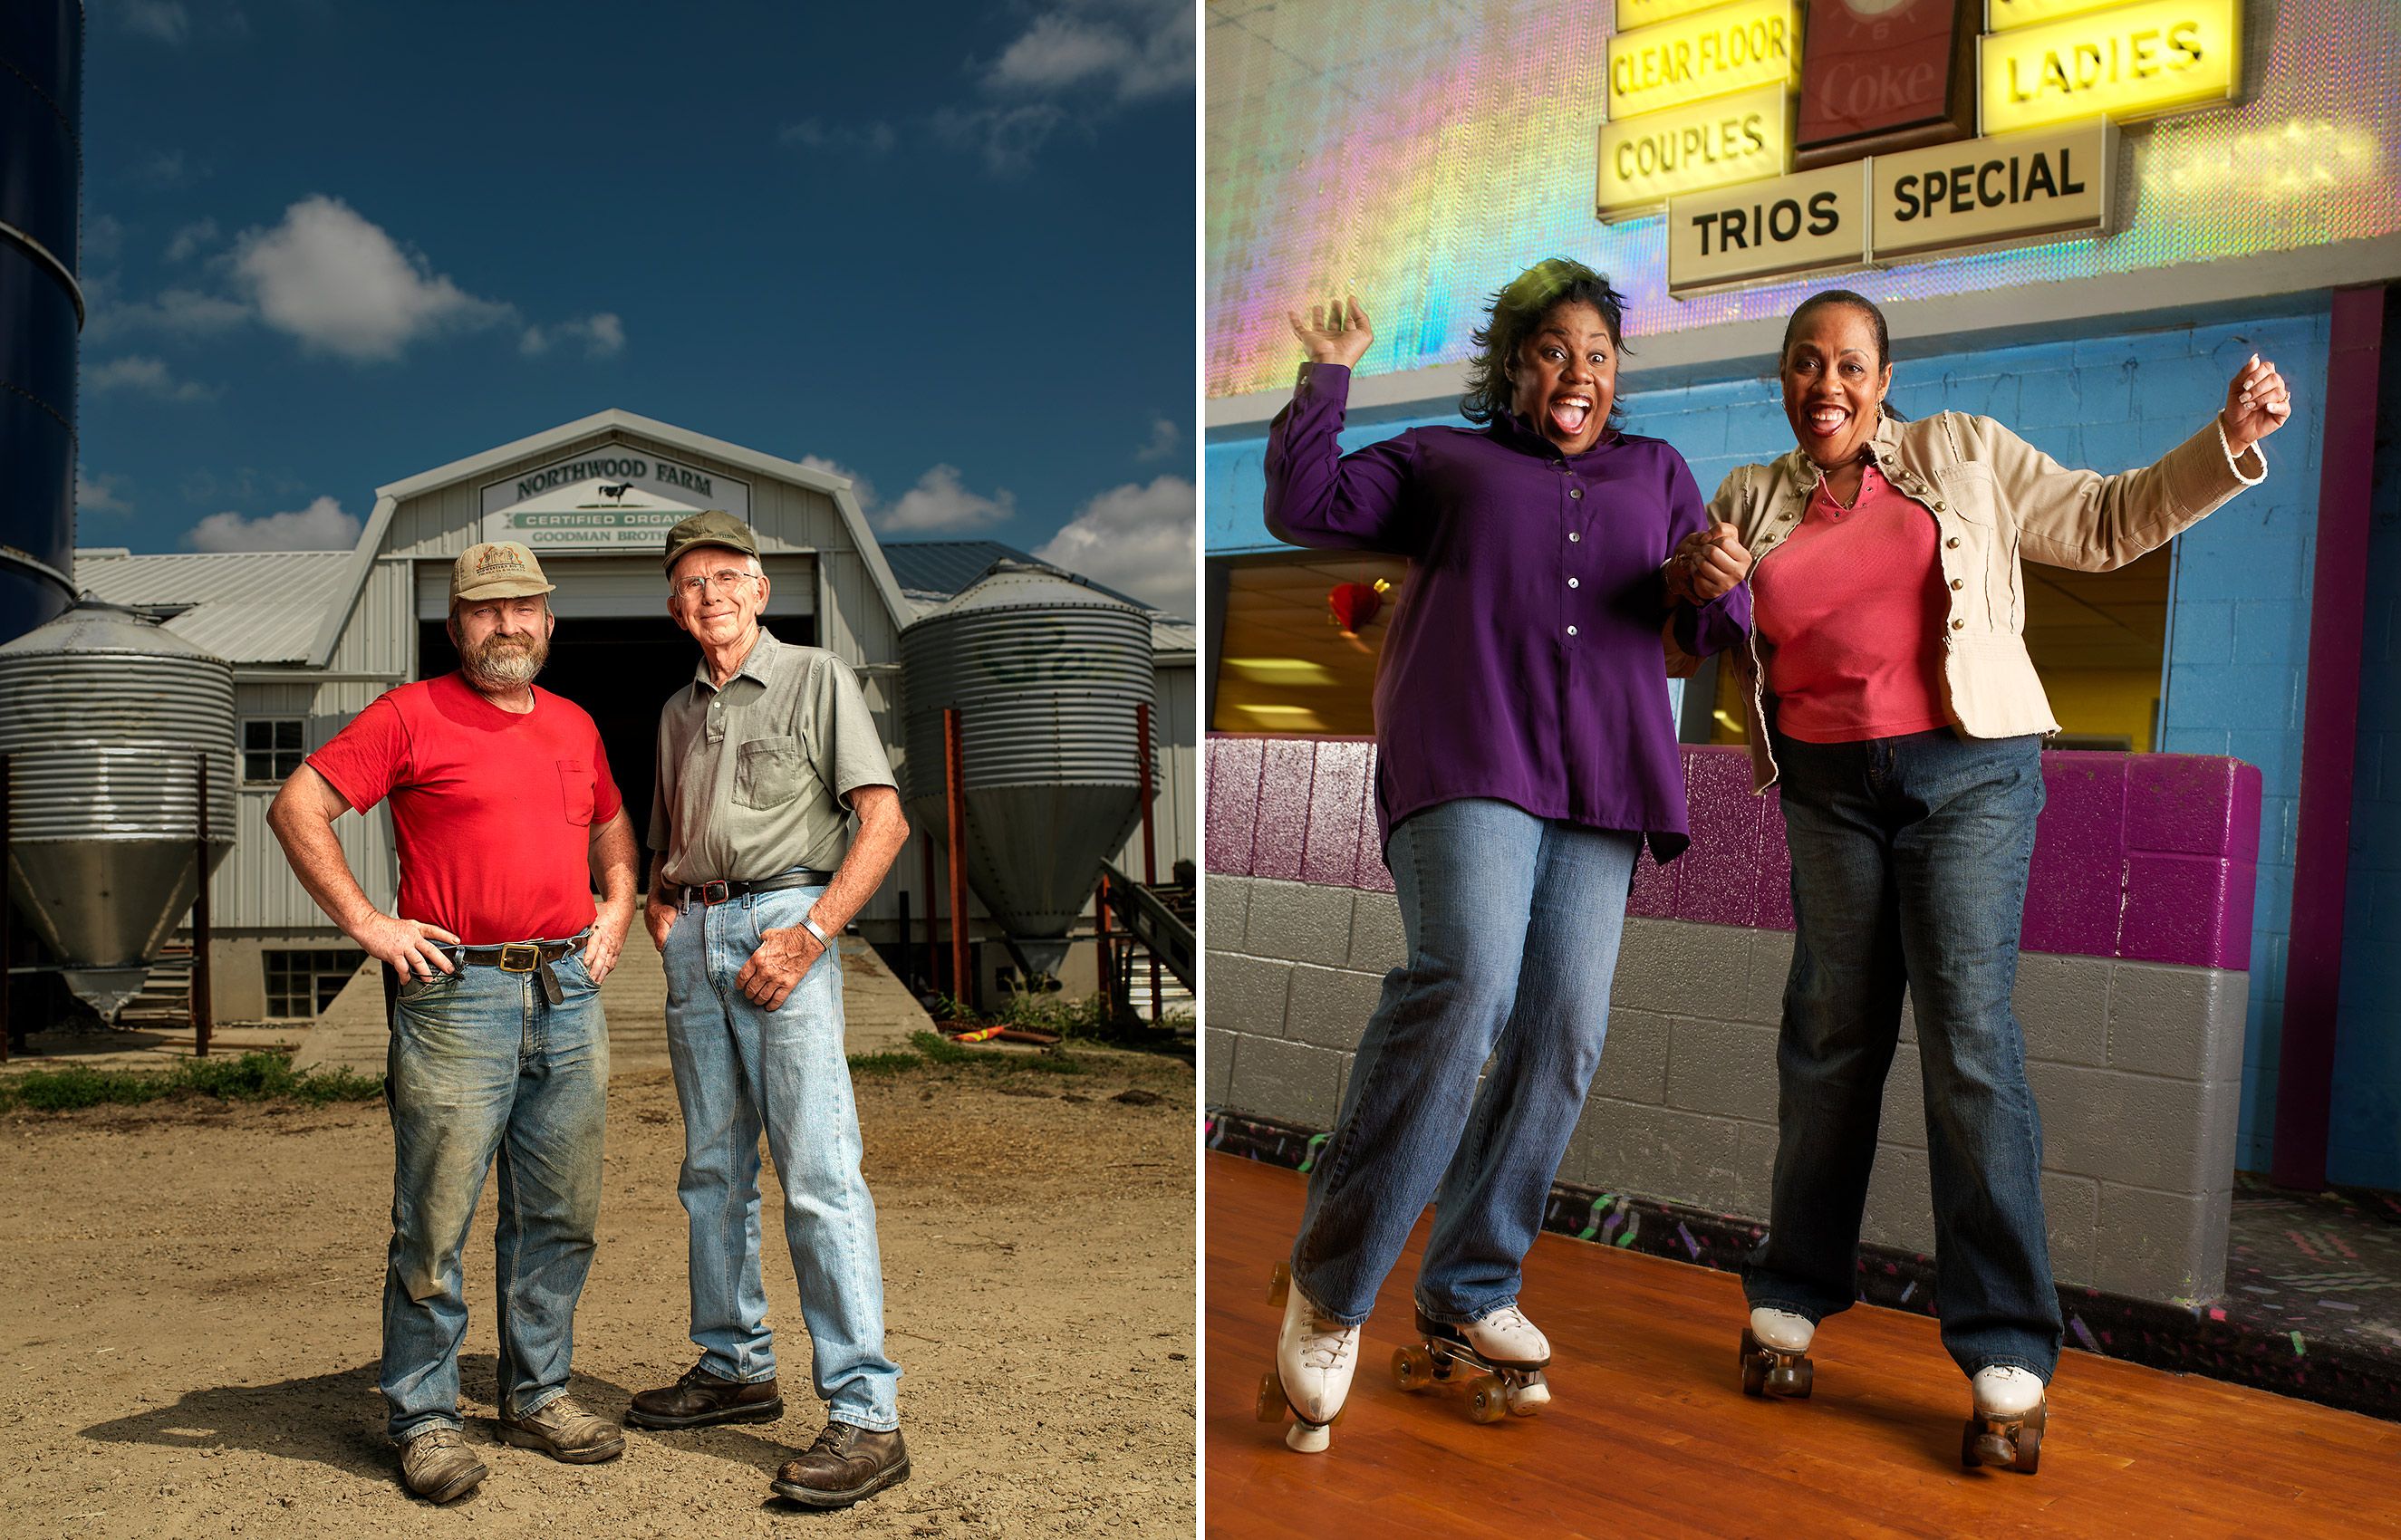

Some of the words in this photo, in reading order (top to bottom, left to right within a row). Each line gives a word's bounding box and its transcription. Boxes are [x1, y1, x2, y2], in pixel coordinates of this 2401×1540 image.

[1612, 39, 1692, 96] CLEAR
[1698, 14, 1787, 75] FLOOR
[2007, 21, 2203, 103] LADIES
[1820, 61, 1935, 120] Coke
[1615, 111, 1764, 180] COUPLES
[1894, 148, 2086, 222] SPECIAL
[1692, 190, 1840, 255] TRIOS
[516, 458, 647, 502] NORTHWOOD
[655, 462, 713, 499] FARM
[526, 515, 616, 525] CERTIFIED
[623, 514, 690, 525] ORGAN
[532, 531, 612, 543] GOODMAN
[618, 530, 667, 542] BROTH
